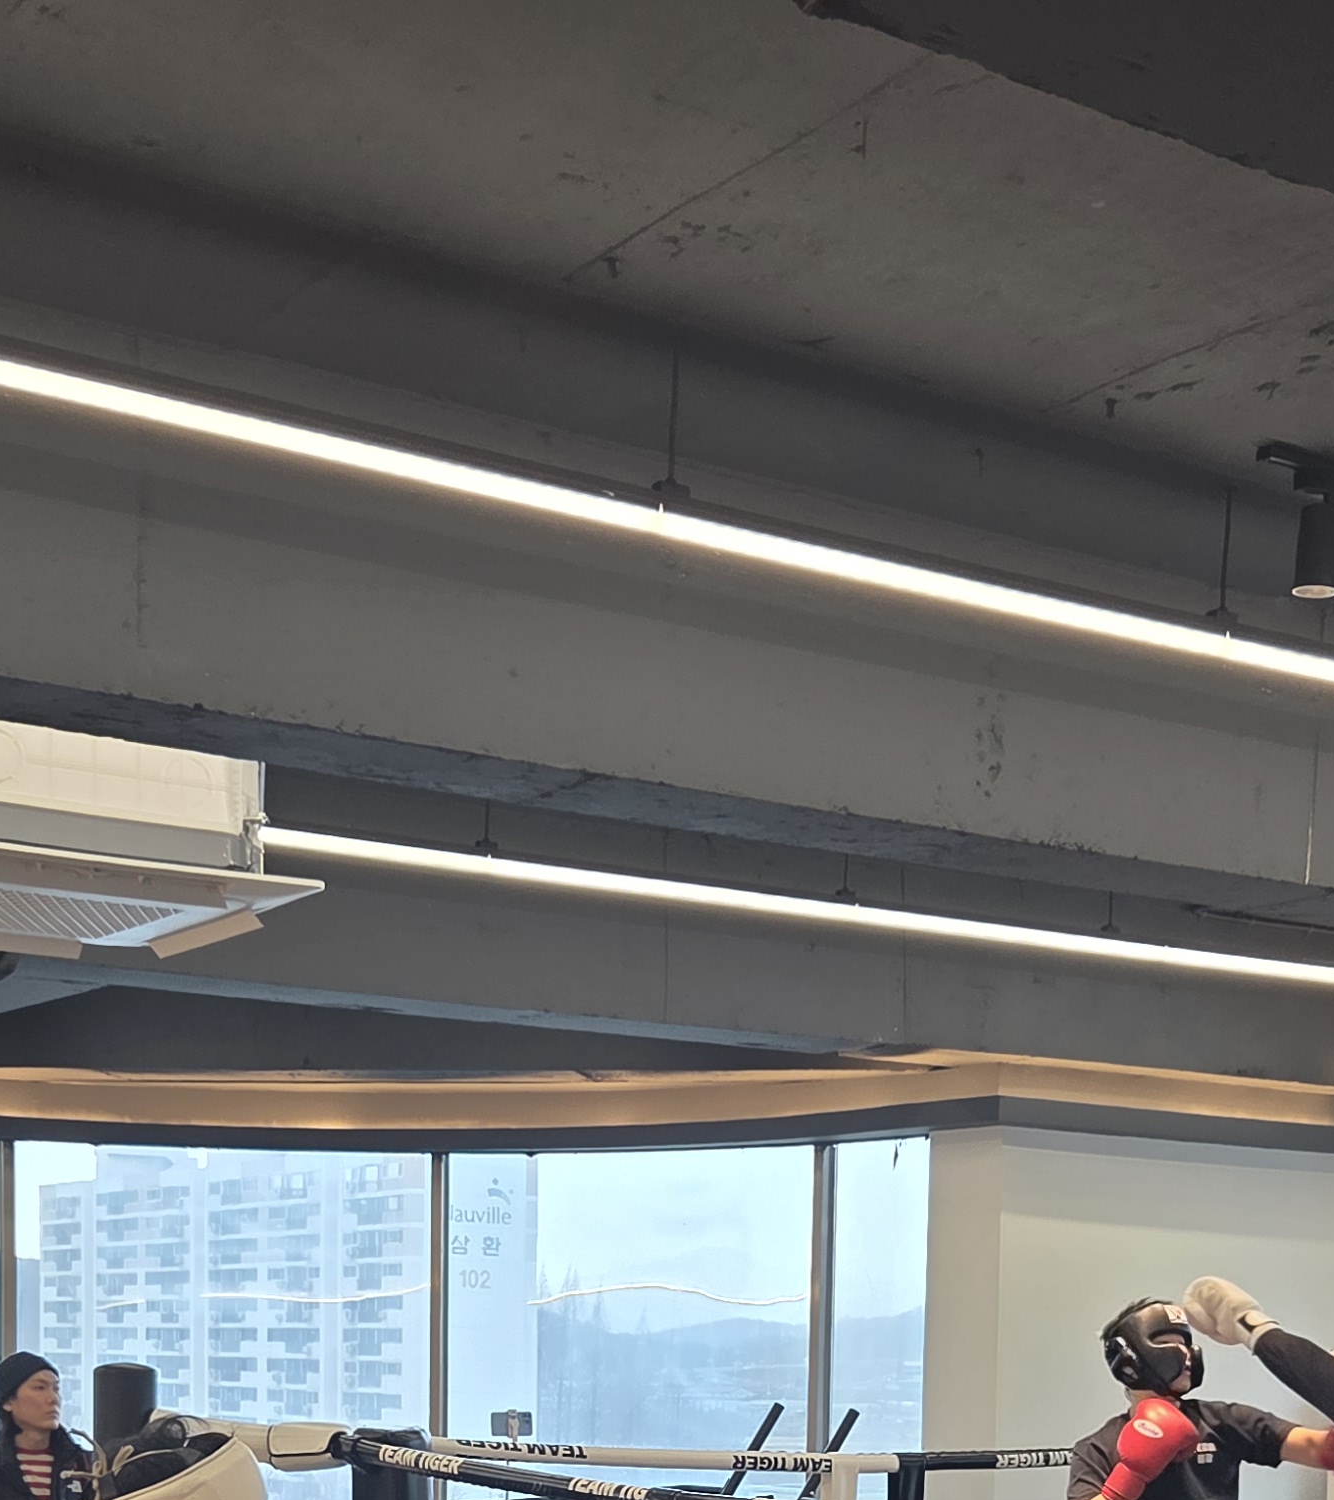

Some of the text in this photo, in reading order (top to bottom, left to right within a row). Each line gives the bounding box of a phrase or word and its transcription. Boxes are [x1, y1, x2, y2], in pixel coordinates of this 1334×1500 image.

[450, 1204, 512, 1225] auville
[458, 1269, 491, 1289] 102
[377, 1444, 465, 1476] TEAM TIGER
[731, 1454, 833, 1473] EAM TIGER
[995, 1452, 1046, 1468] TIGER
